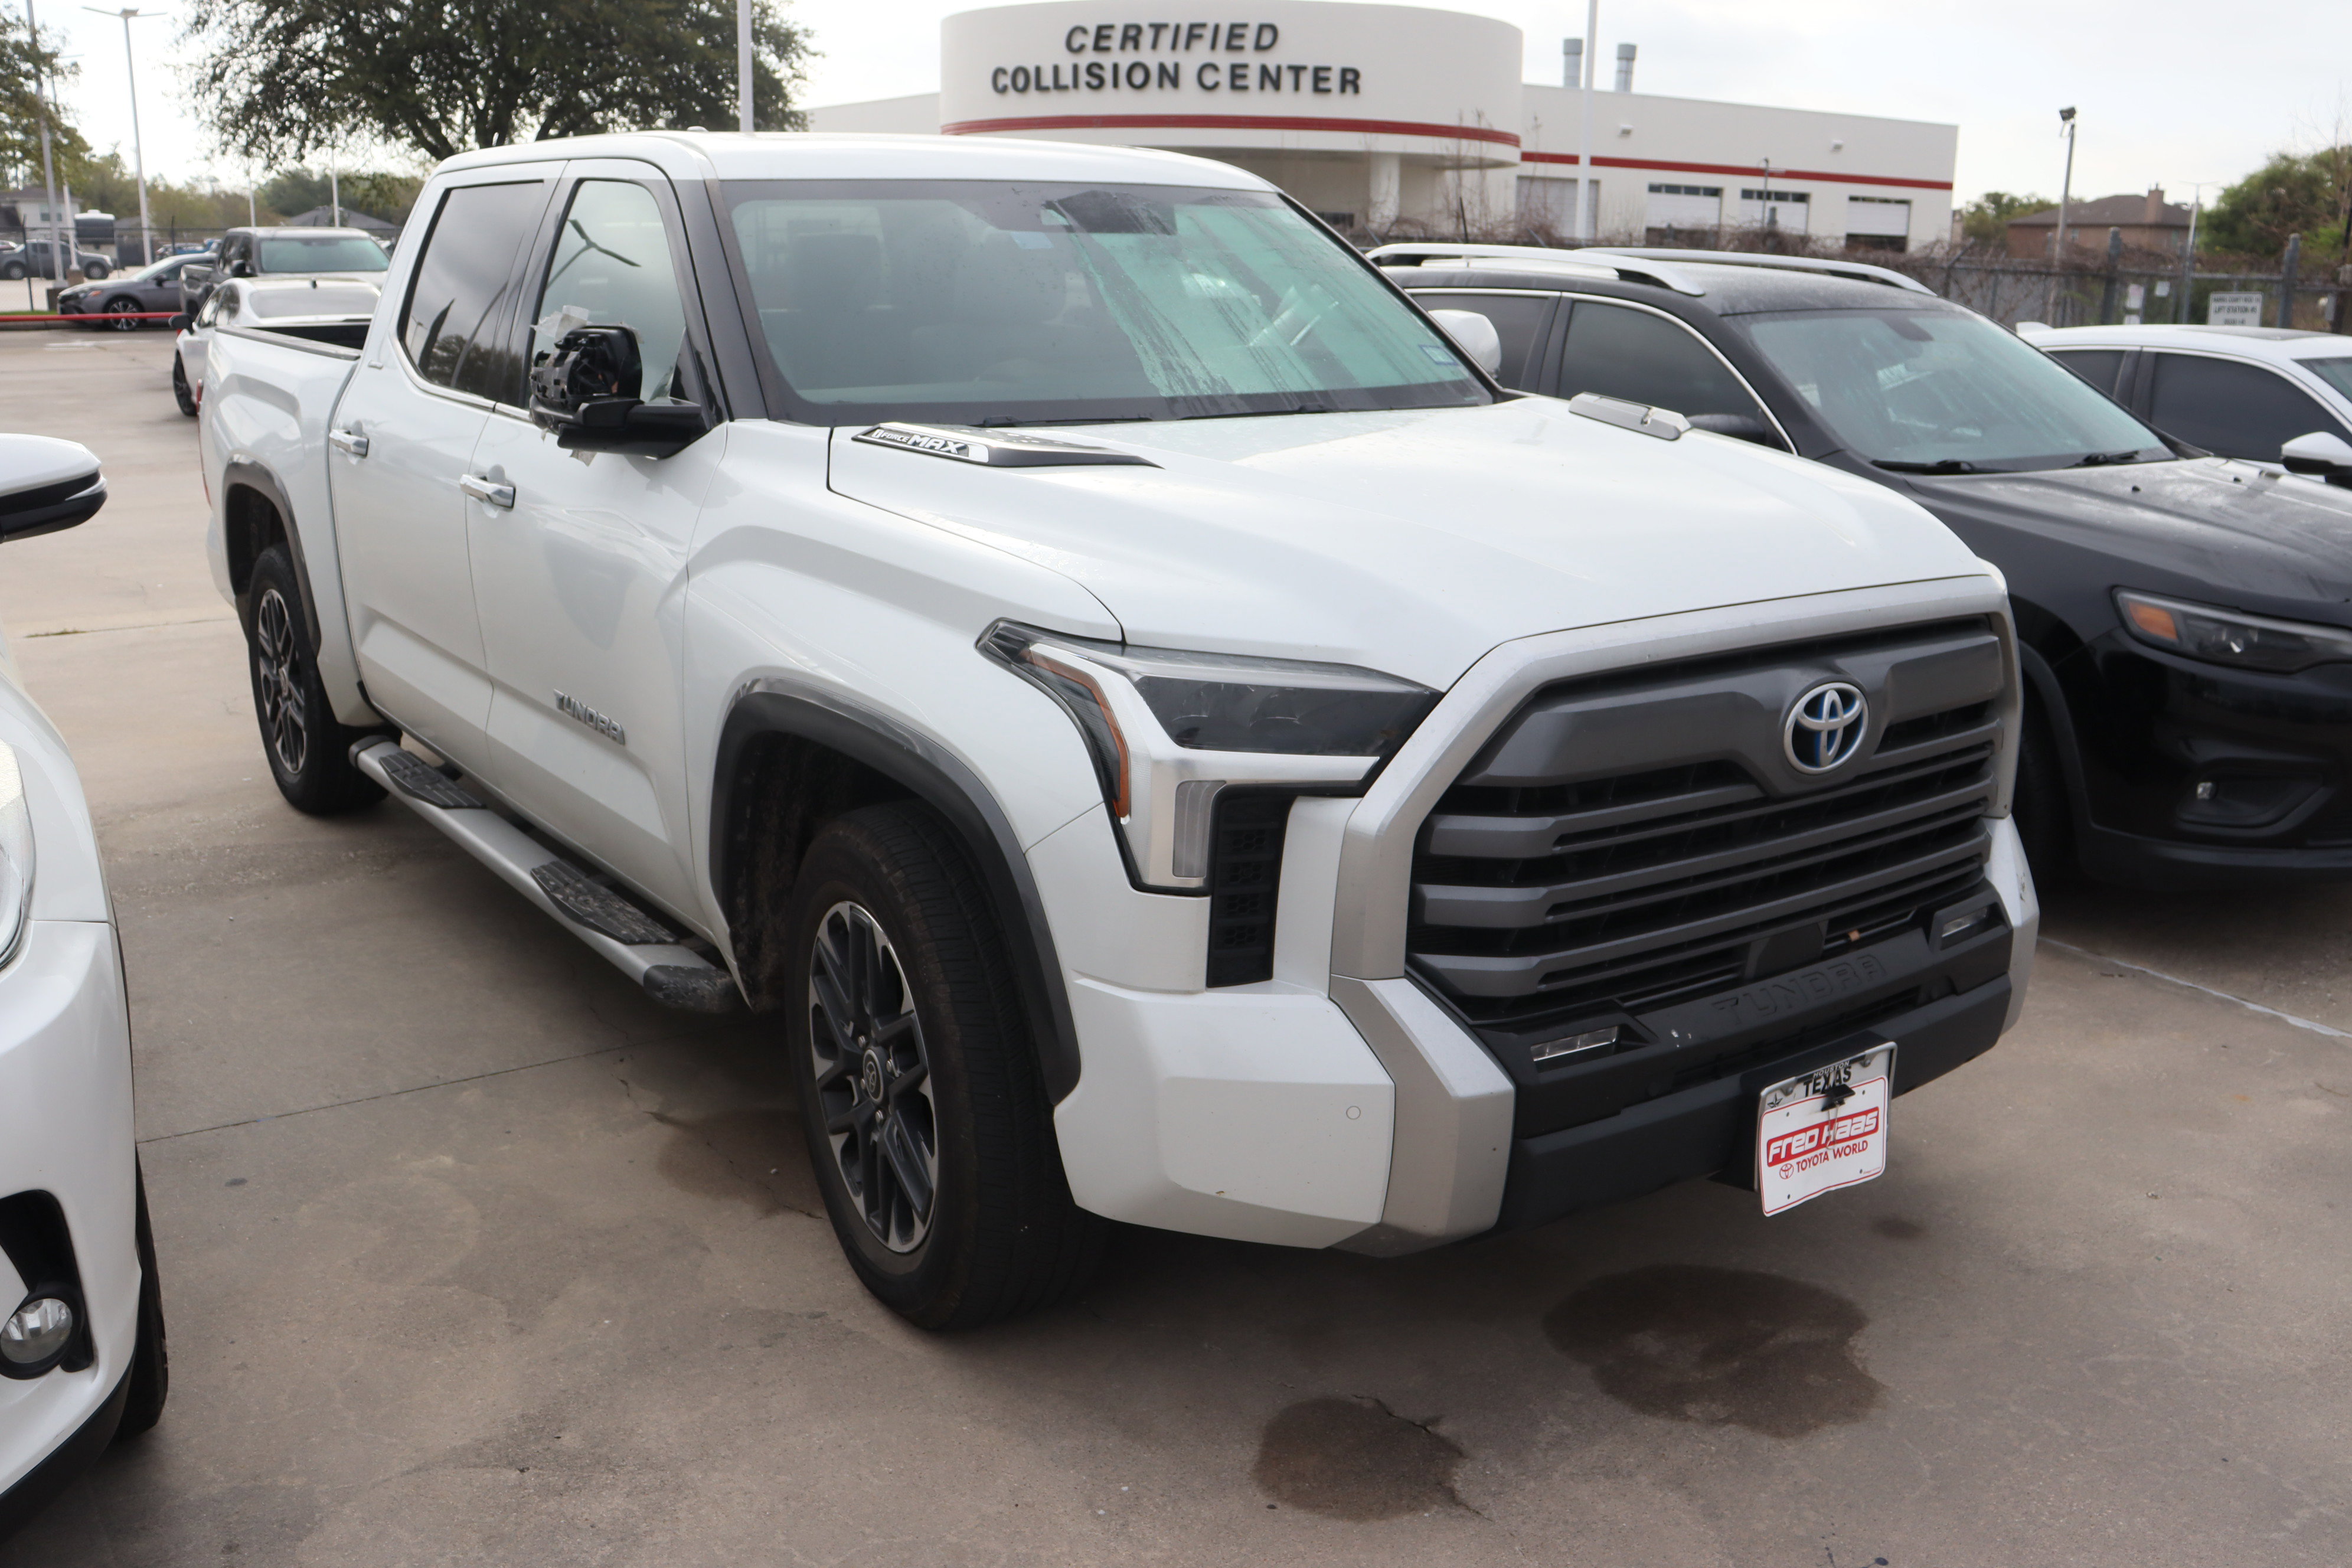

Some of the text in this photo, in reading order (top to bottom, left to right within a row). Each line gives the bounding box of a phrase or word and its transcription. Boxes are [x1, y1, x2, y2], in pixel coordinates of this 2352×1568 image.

[1065, 23, 1279, 53] CERTIFIED
[992, 61, 1361, 94] COLLISION CENTER
[907, 435, 967, 454] MAX
[553, 688, 626, 746] TUNDRA
[1711, 954, 1887, 1026] TUNDRA
[1804, 1065, 1852, 1097] TEXAS
[1813, 1060, 1850, 1078] HOUSTON
[1796, 1140, 1868, 1172] TOYOTA WORLD
